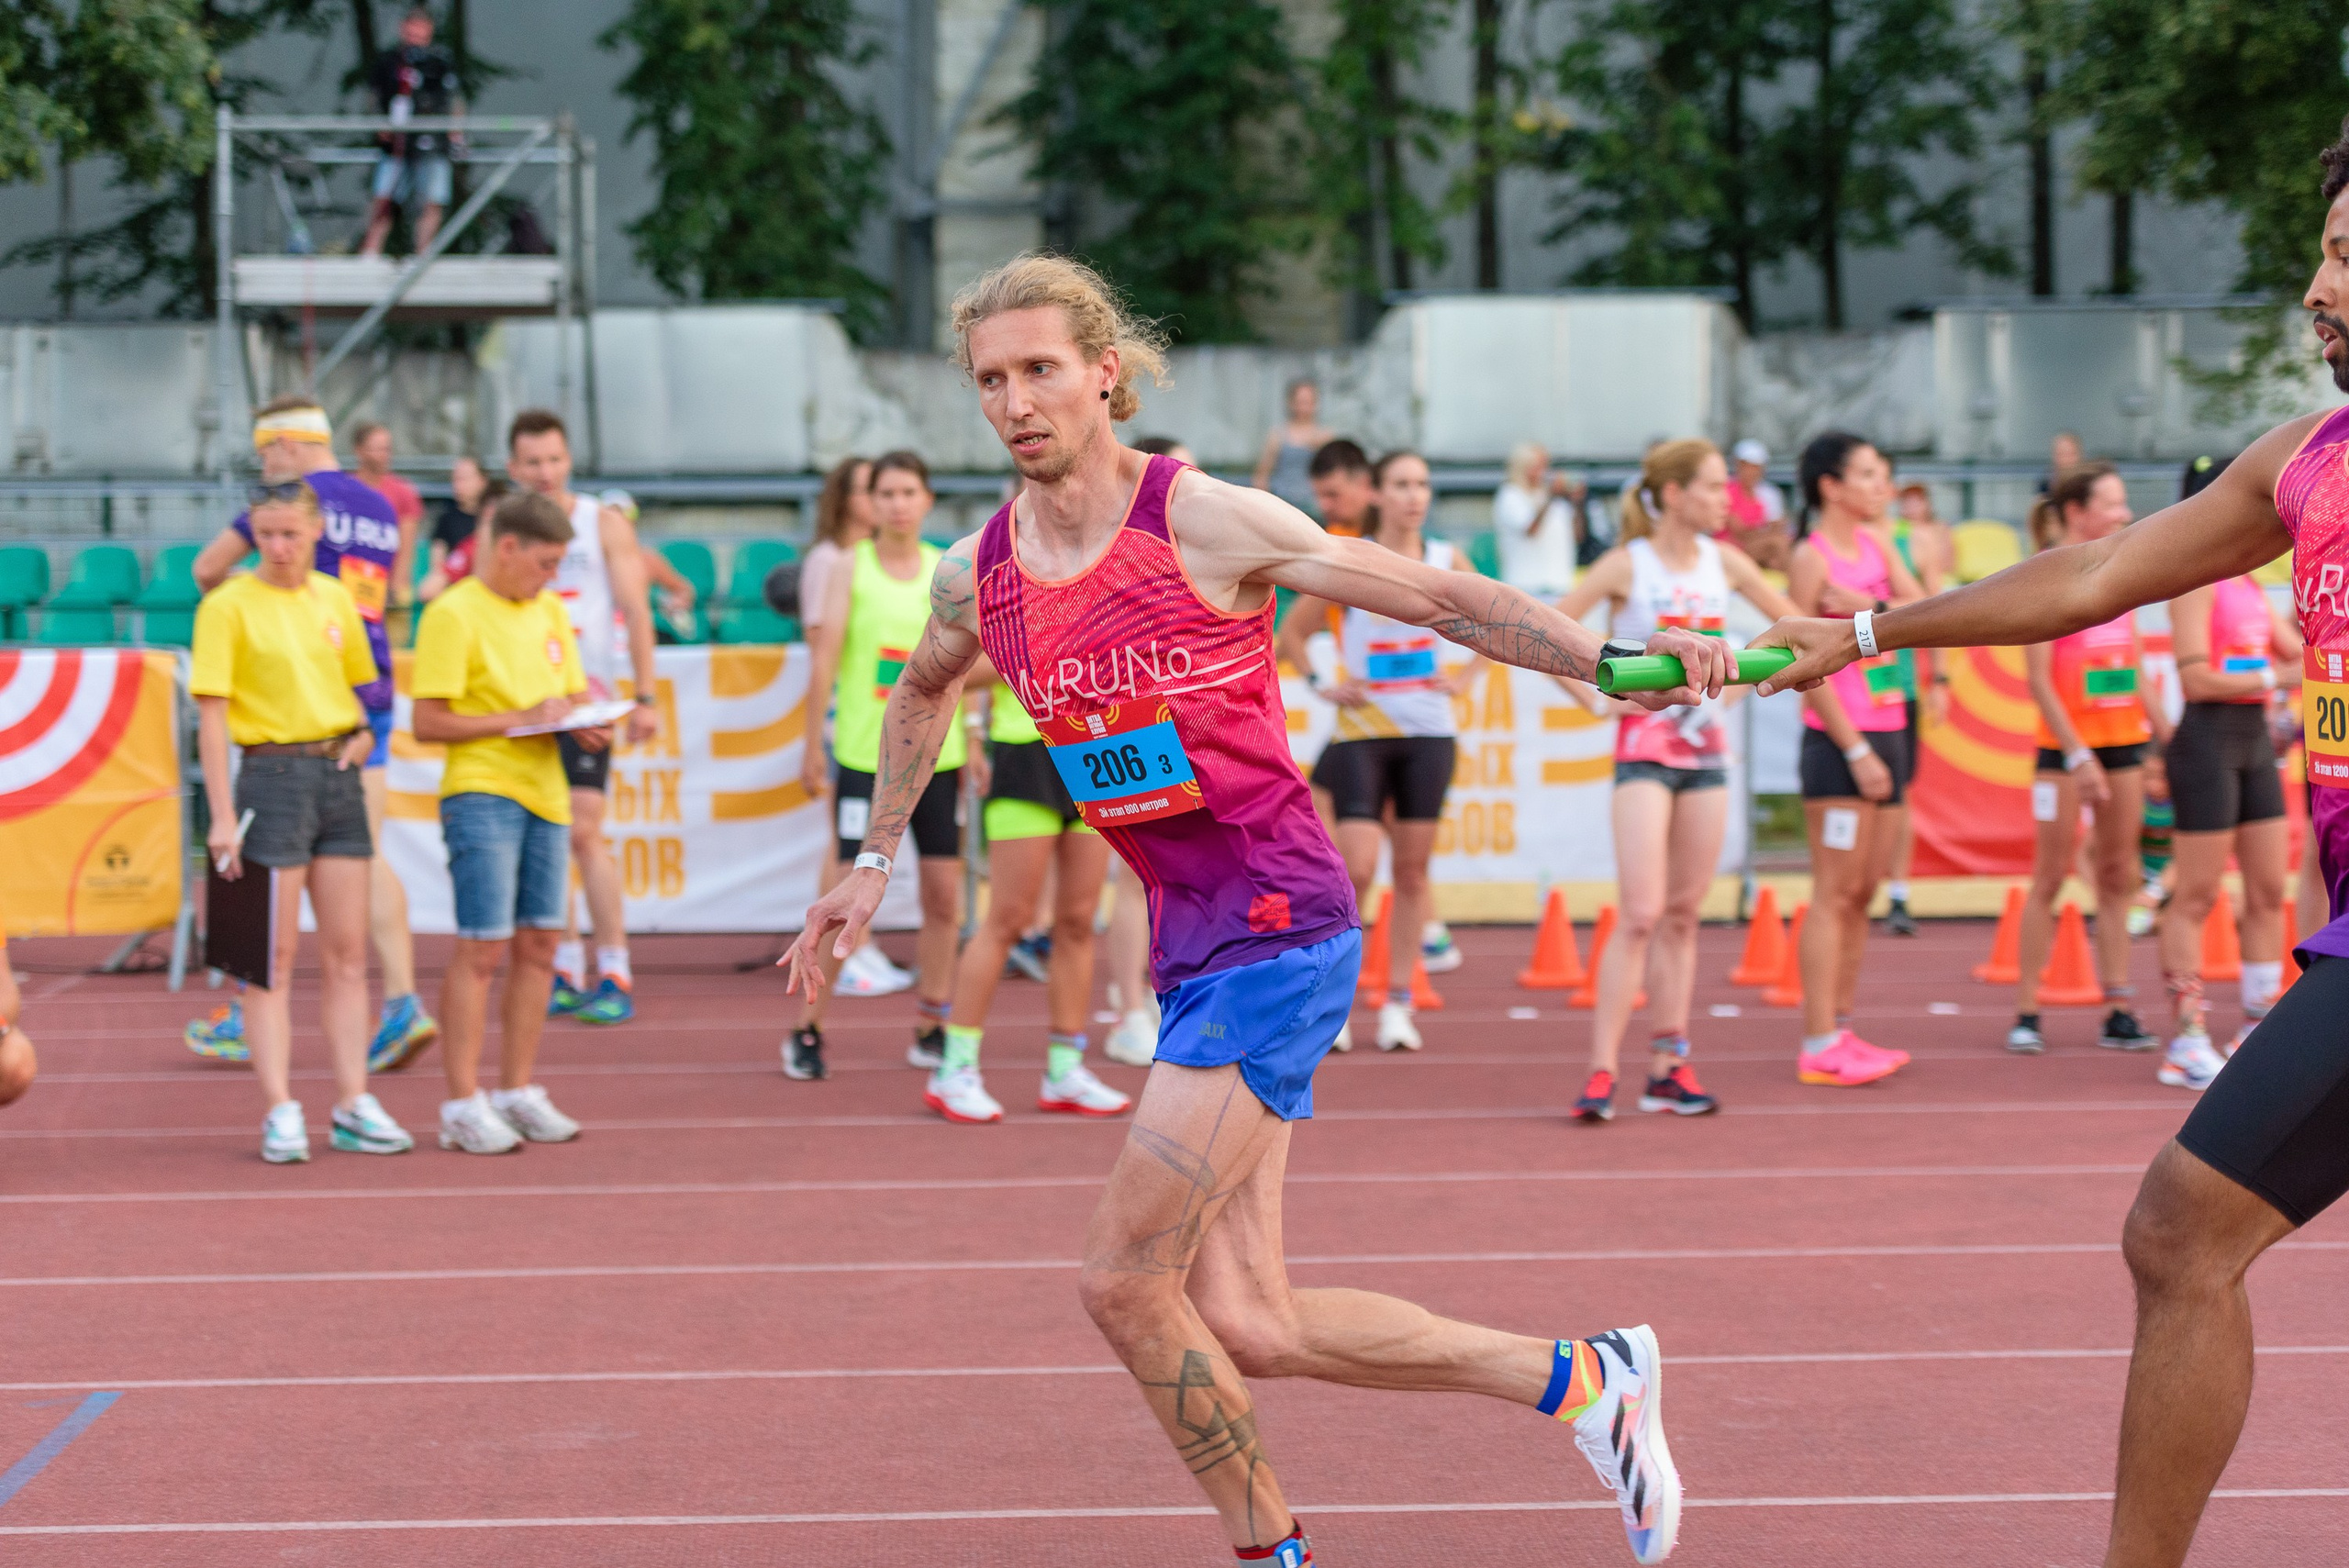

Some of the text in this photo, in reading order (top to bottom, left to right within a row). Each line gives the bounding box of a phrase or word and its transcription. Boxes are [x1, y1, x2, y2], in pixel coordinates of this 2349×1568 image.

[1859, 630, 1872, 648] 217
[2317, 695, 2349, 742] 20
[1083, 744, 1173, 789] 206 3
[2332, 764, 2349, 778] 1200
[1108, 807, 1126, 817] этап
[1124, 803, 1140, 814] 800
[1139, 797, 1170, 812] метров
